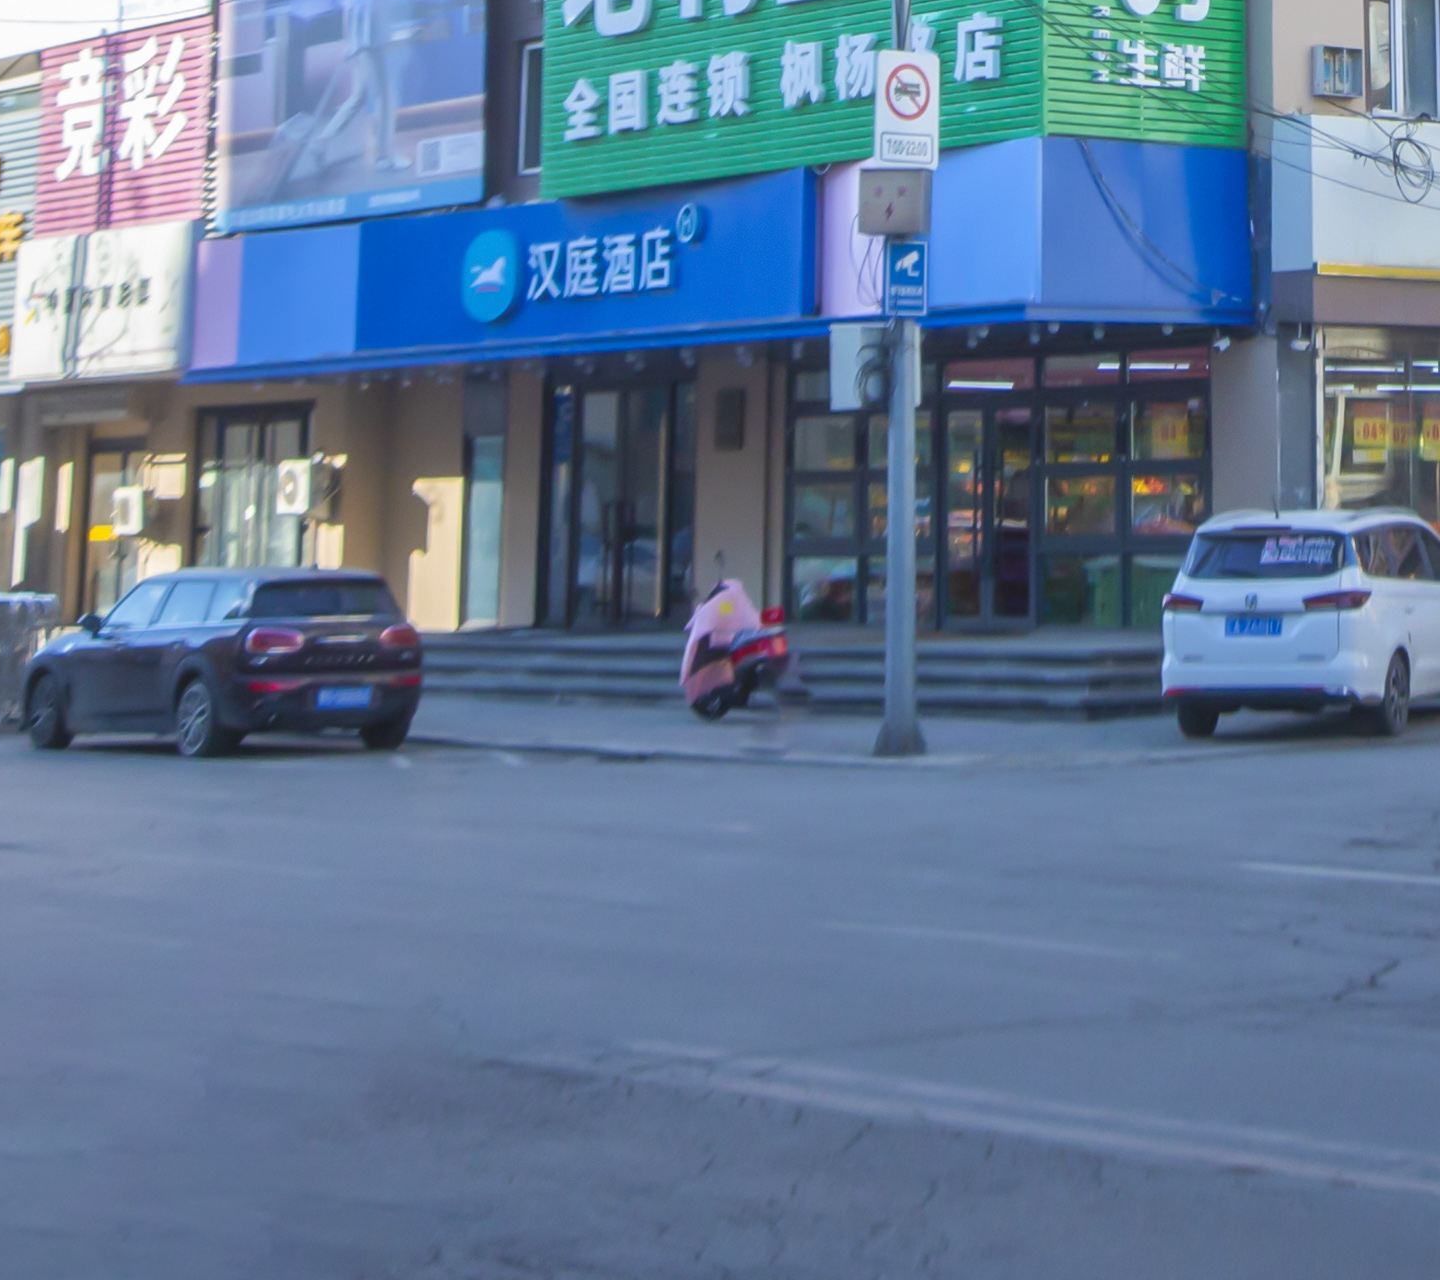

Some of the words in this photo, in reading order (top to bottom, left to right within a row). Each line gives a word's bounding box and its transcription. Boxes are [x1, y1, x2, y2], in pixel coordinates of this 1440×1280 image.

[563, 50, 752, 143] 全国连锁
[1116, 39, 1206, 93] 生鲜
[53, 35, 188, 183] 竞彩
[526, 225, 672, 302] 汉庭酒店
